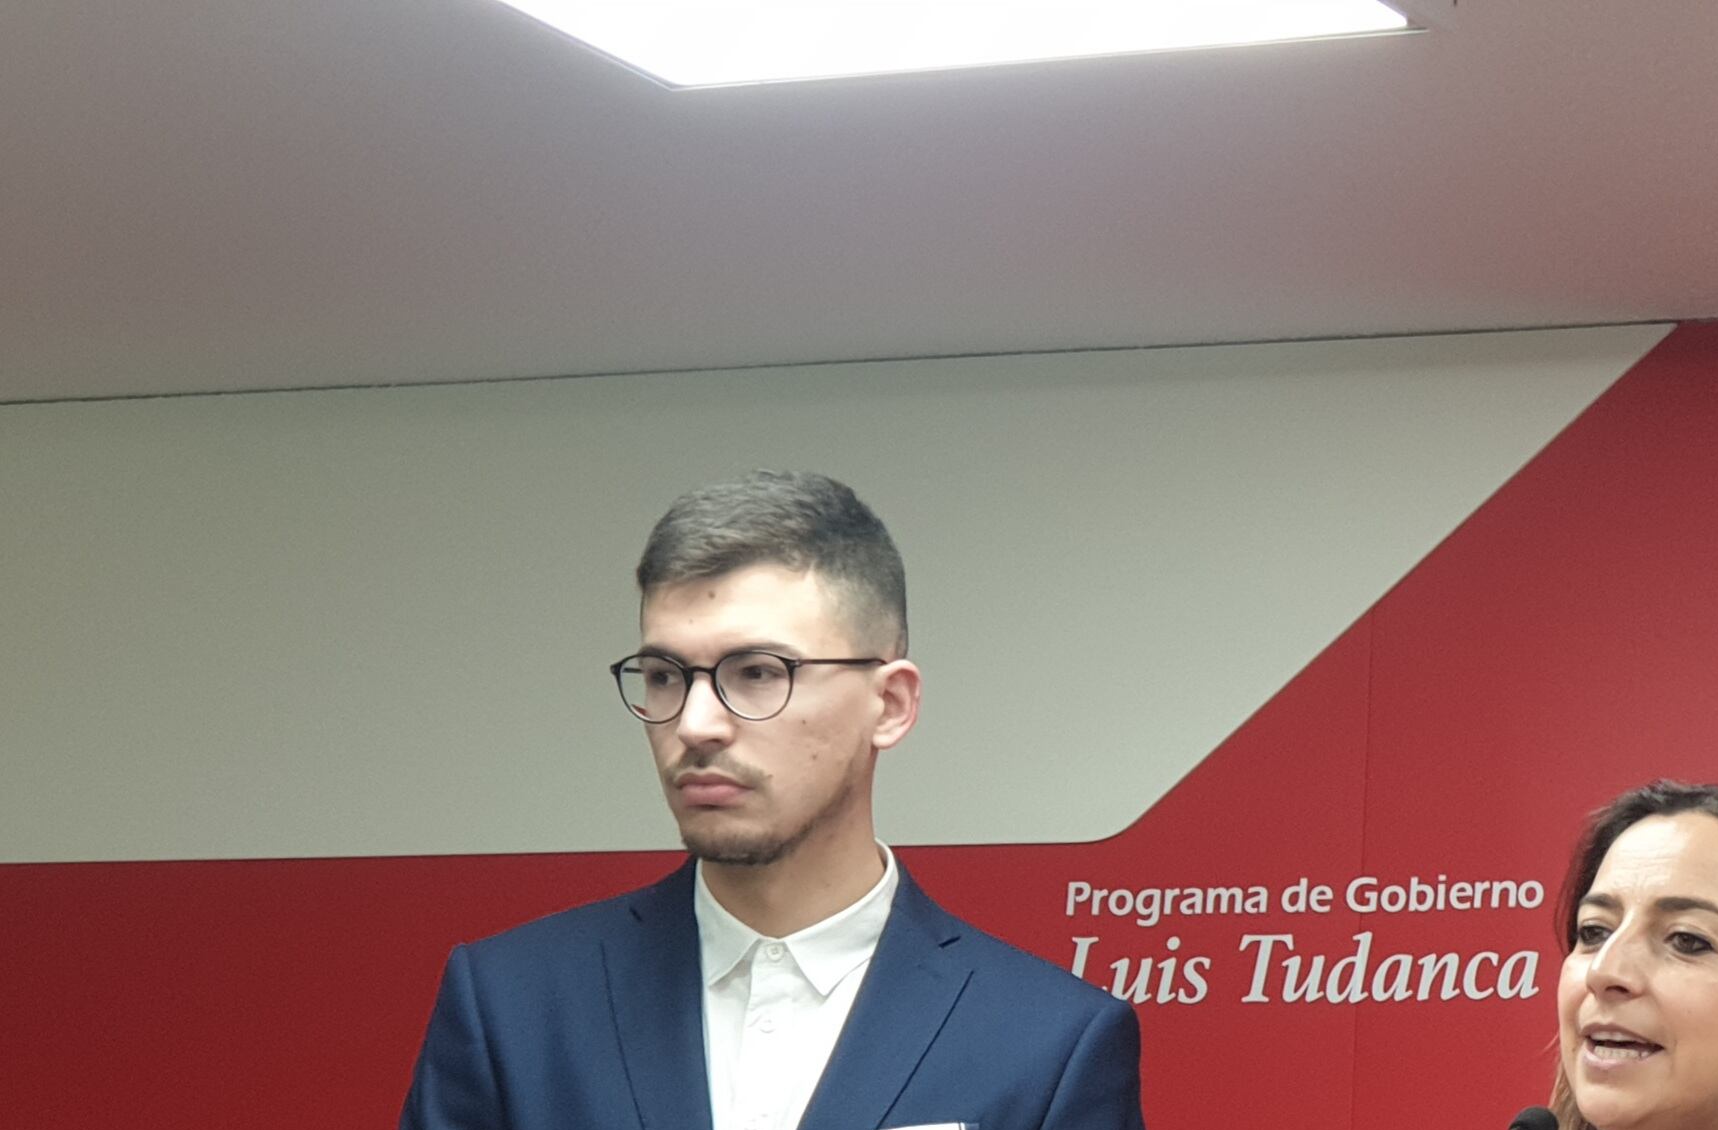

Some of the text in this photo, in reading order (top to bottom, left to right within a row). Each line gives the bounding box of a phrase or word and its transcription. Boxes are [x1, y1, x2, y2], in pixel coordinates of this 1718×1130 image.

[1065, 874, 1545, 927] Programa de Gobierno
[1239, 931, 1540, 1004] Tudanca
